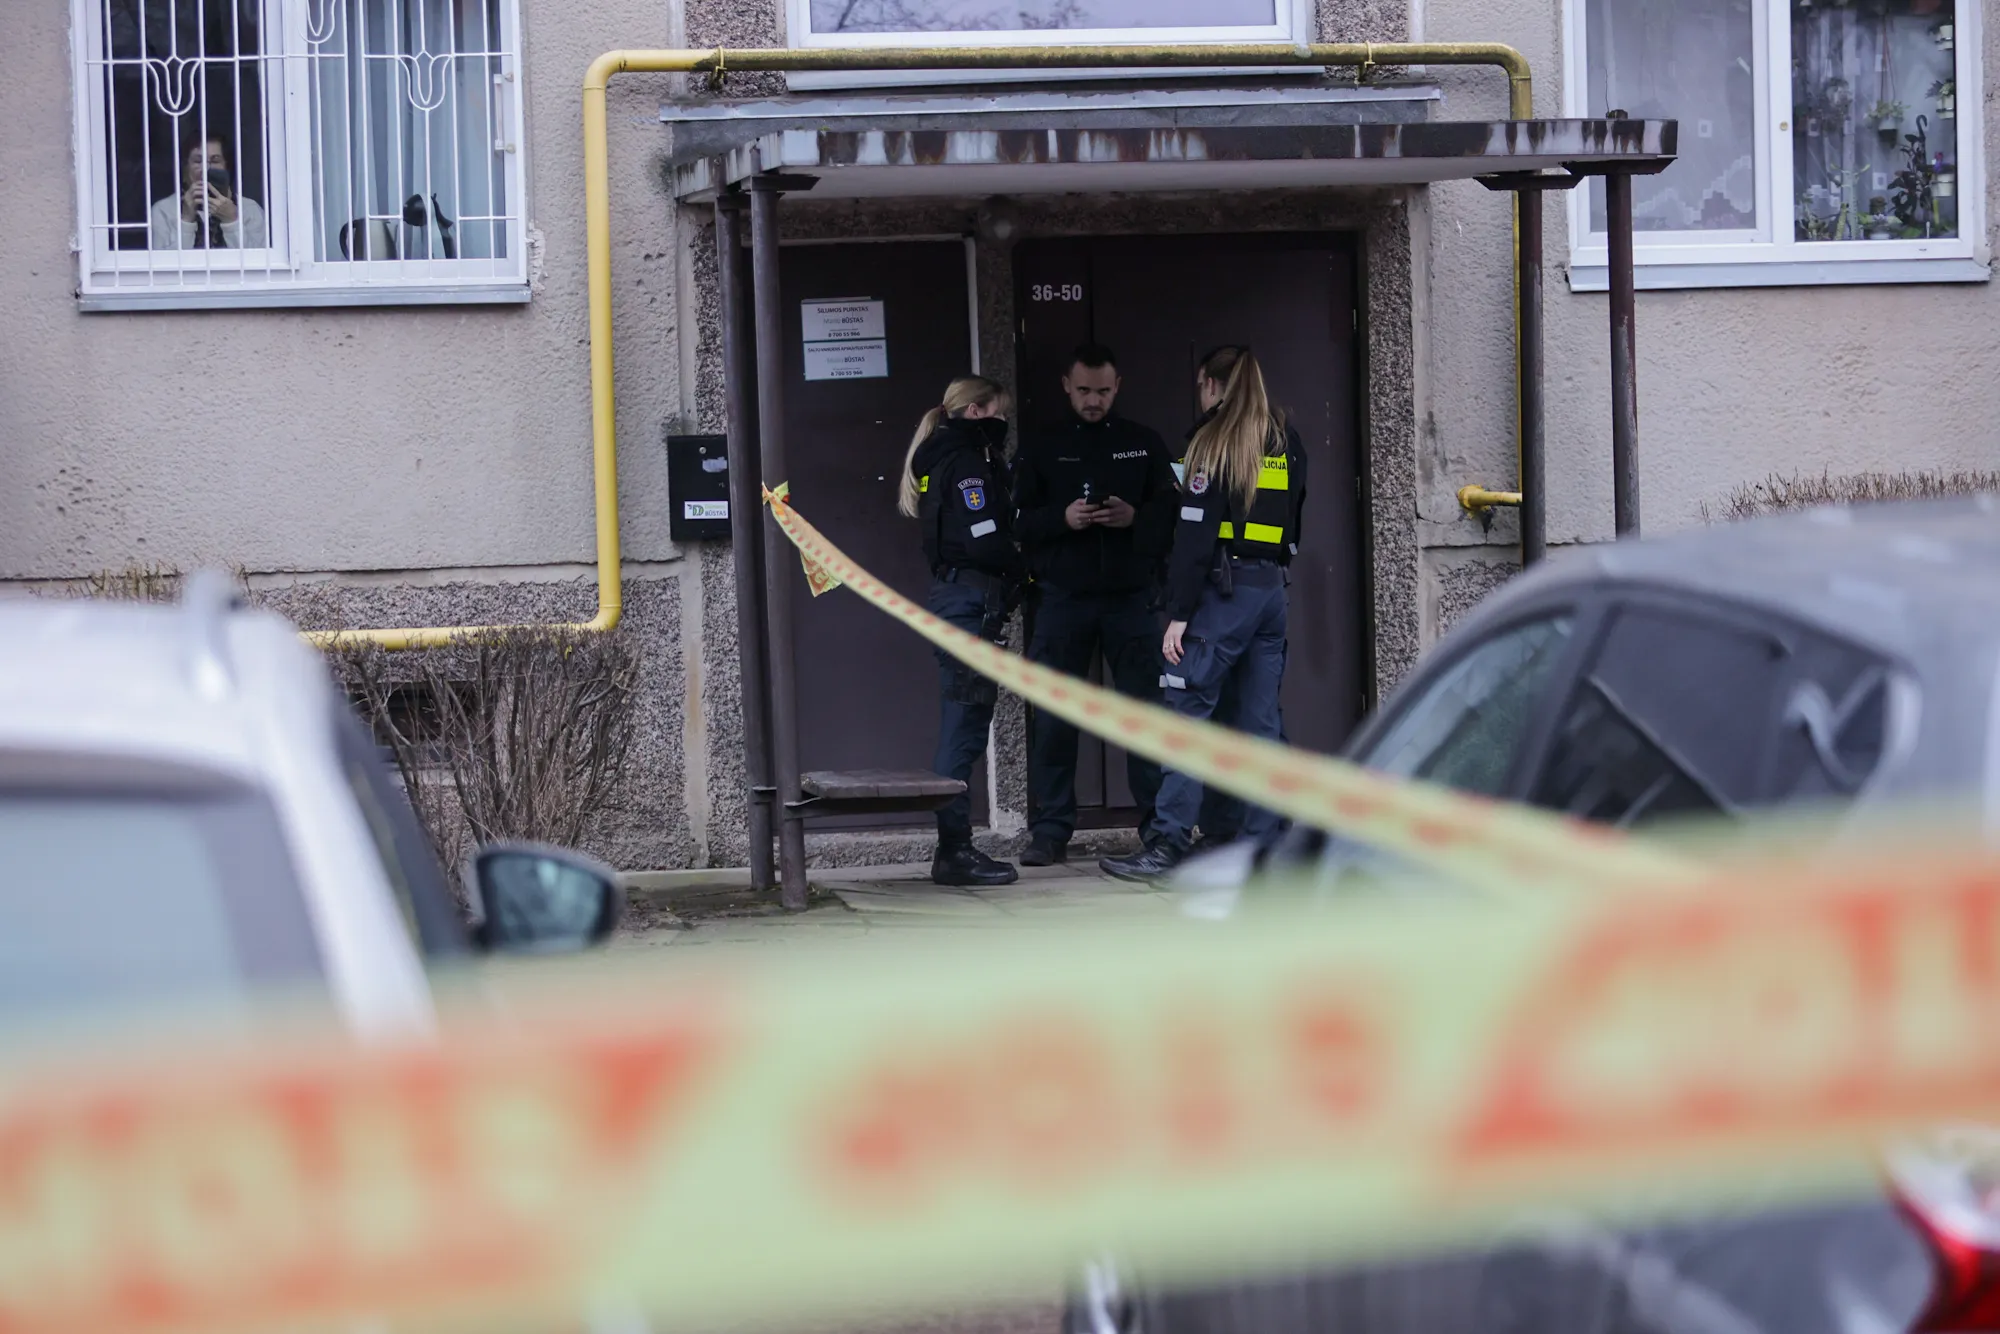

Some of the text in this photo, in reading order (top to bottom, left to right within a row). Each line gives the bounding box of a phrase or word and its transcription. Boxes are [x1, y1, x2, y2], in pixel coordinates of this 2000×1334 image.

[1032, 284, 1082, 301] 36-50
[1112, 449, 1148, 461] POLICIJA
[1258, 459, 1287, 471] OLICIJA
[959, 479, 982, 489] LIETUVA
